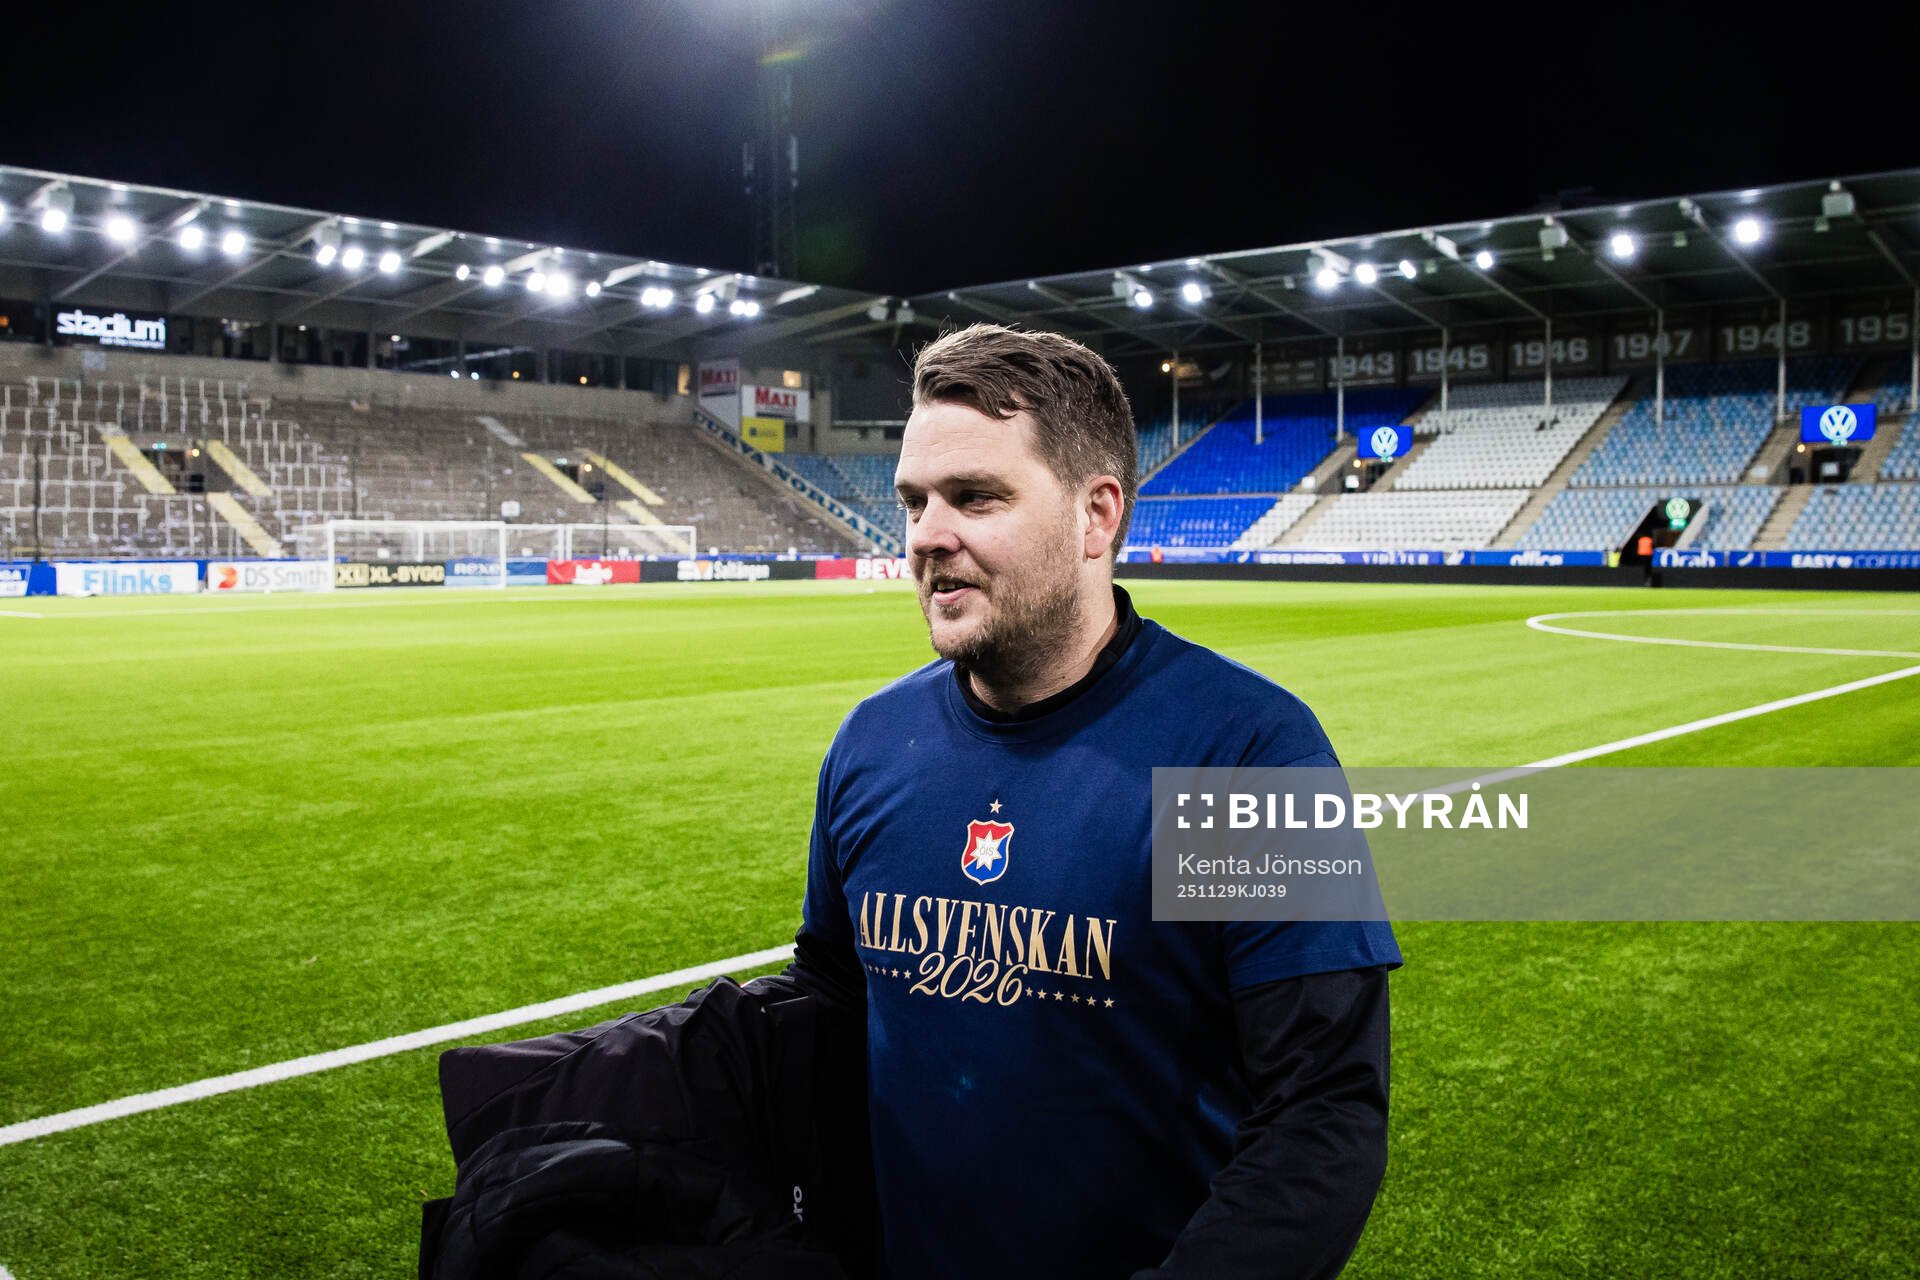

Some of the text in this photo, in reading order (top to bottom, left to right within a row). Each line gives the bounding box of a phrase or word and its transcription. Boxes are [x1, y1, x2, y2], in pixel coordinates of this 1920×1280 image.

[56, 309, 166, 341] stadium
[1721, 321, 1811, 353] 1948
[1841, 314, 1912, 344] 195
[1411, 344, 1488, 372] 1945
[1511, 337, 1589, 366] 1946
[1613, 329, 1693, 359] 1947
[1328, 351, 1394, 379] 1943
[83, 569, 173, 593] Flinks
[245, 566, 328, 587] DS Smith
[370, 565, 445, 583] XL-BYGG
[859, 891, 1118, 980] ALLSVENSKAN
[909, 951, 1029, 1007] 2026
